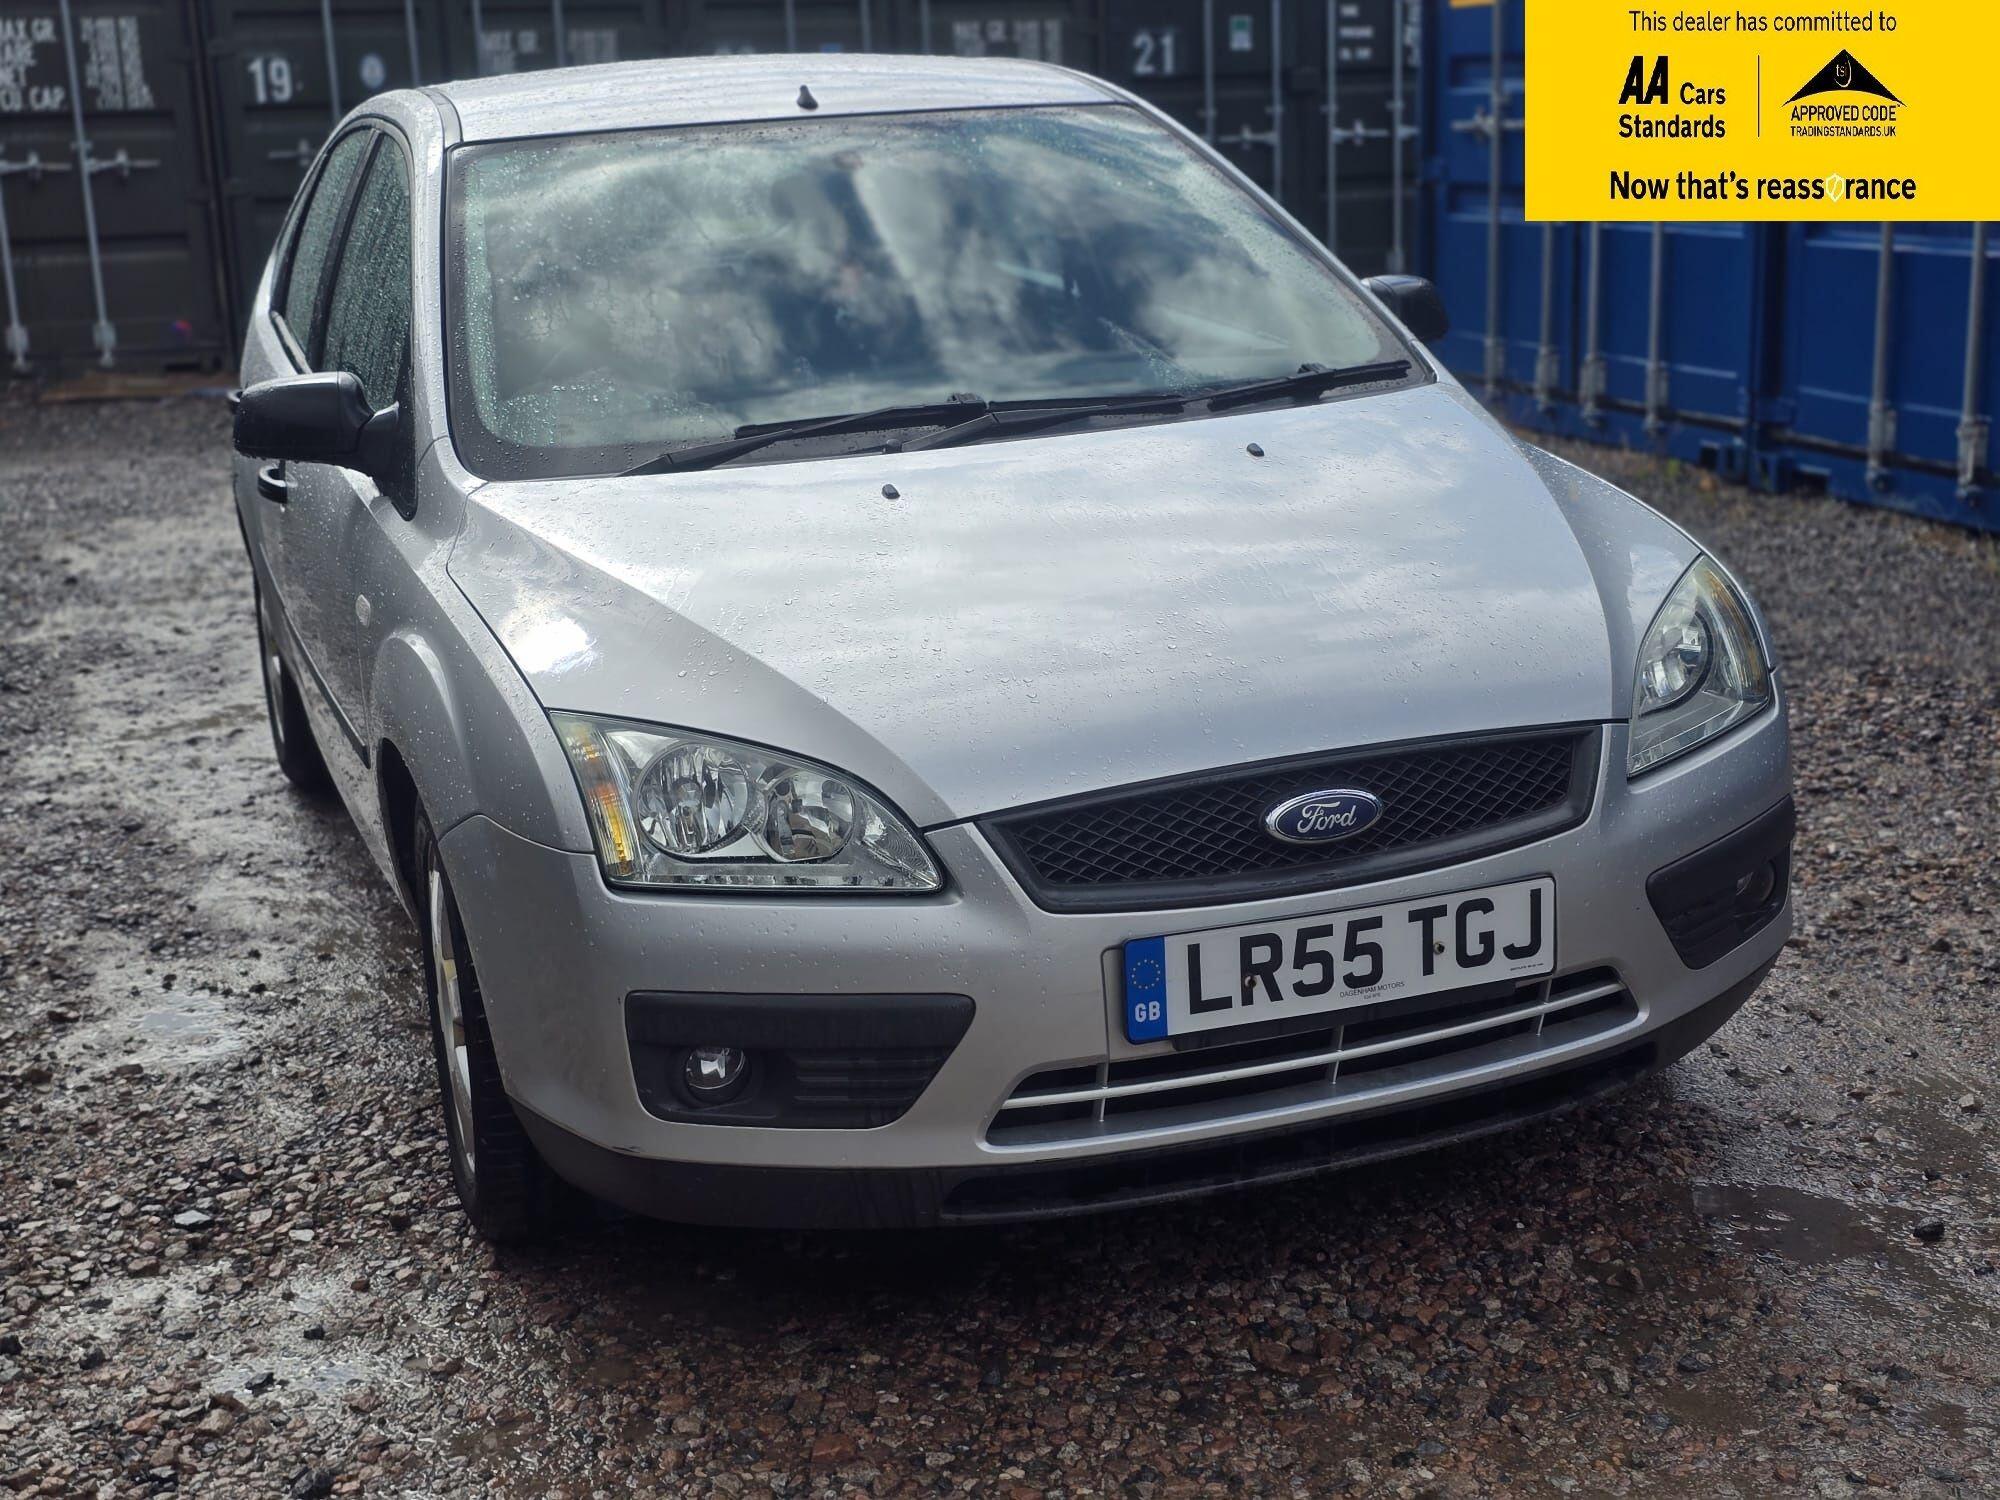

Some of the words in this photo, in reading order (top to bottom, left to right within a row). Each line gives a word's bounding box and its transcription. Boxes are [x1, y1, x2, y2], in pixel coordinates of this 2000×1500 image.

[1132, 31, 1175, 75] 21
[247, 57, 293, 103] 19
[1297, 801, 1357, 833] Ford
[1186, 915, 1384, 1016] LR55
[1407, 887, 1543, 977] TGJ
[1377, 981, 1406, 992] MOTORS
[1134, 1000, 1161, 1022] GB
